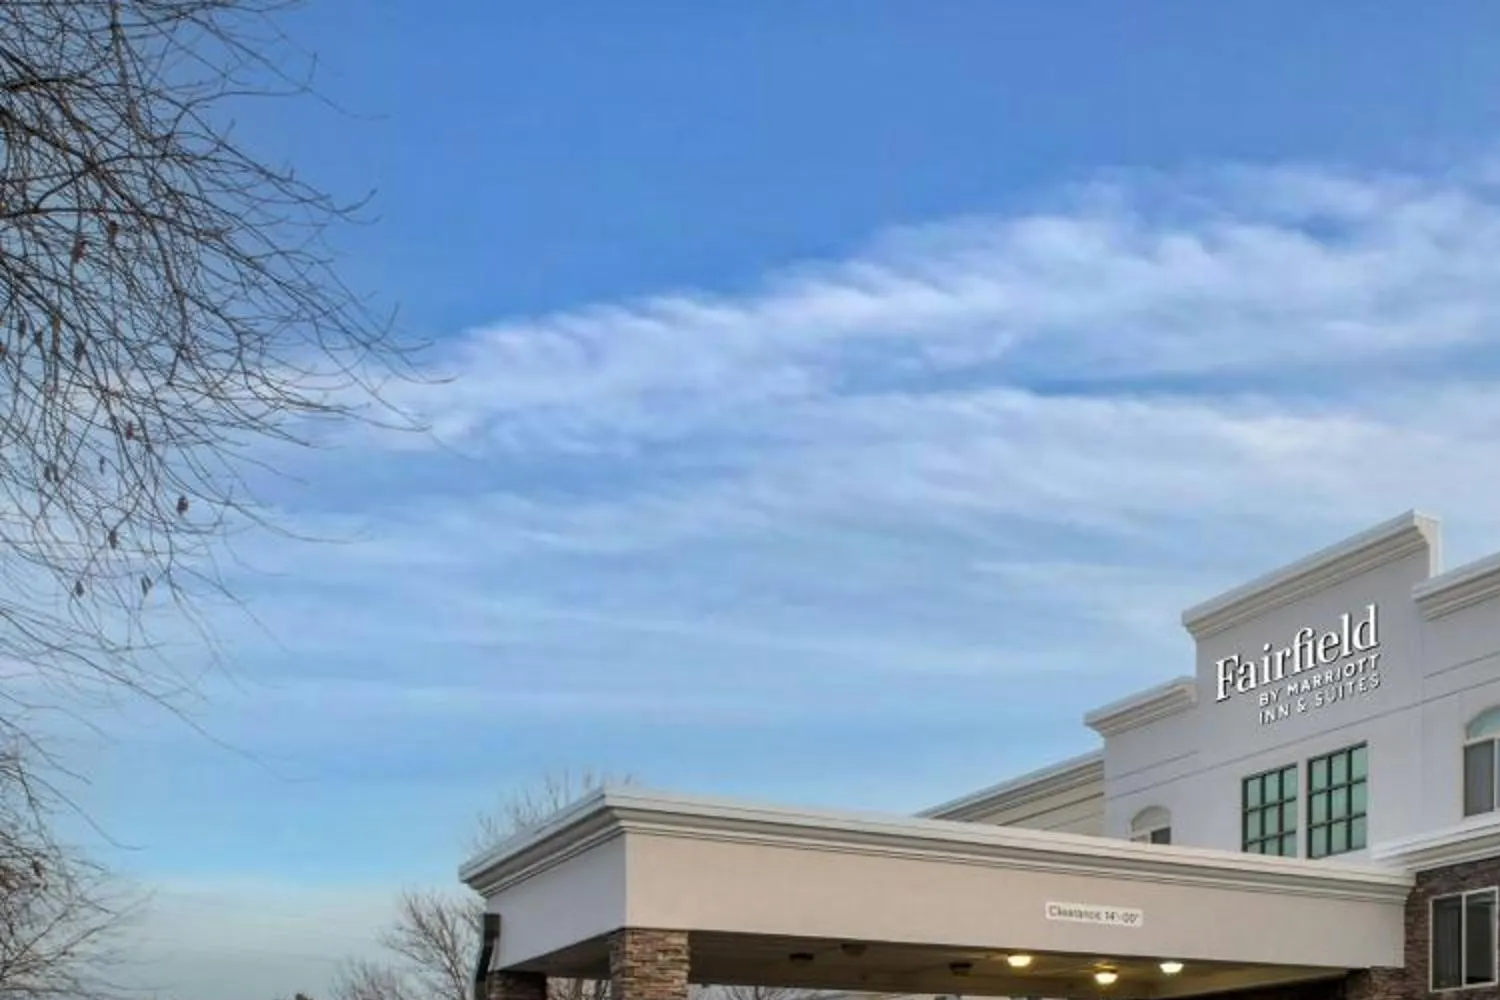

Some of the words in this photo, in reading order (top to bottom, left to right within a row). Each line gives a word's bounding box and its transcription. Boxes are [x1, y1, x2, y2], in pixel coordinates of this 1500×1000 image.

[1215, 602, 1380, 703] Fairfield
[1259, 687, 1282, 708] BY
[1287, 653, 1381, 697] MARRIOTT
[1259, 703, 1291, 725] INN
[1297, 695, 1307, 713] &
[1314, 672, 1381, 708] SUITES
